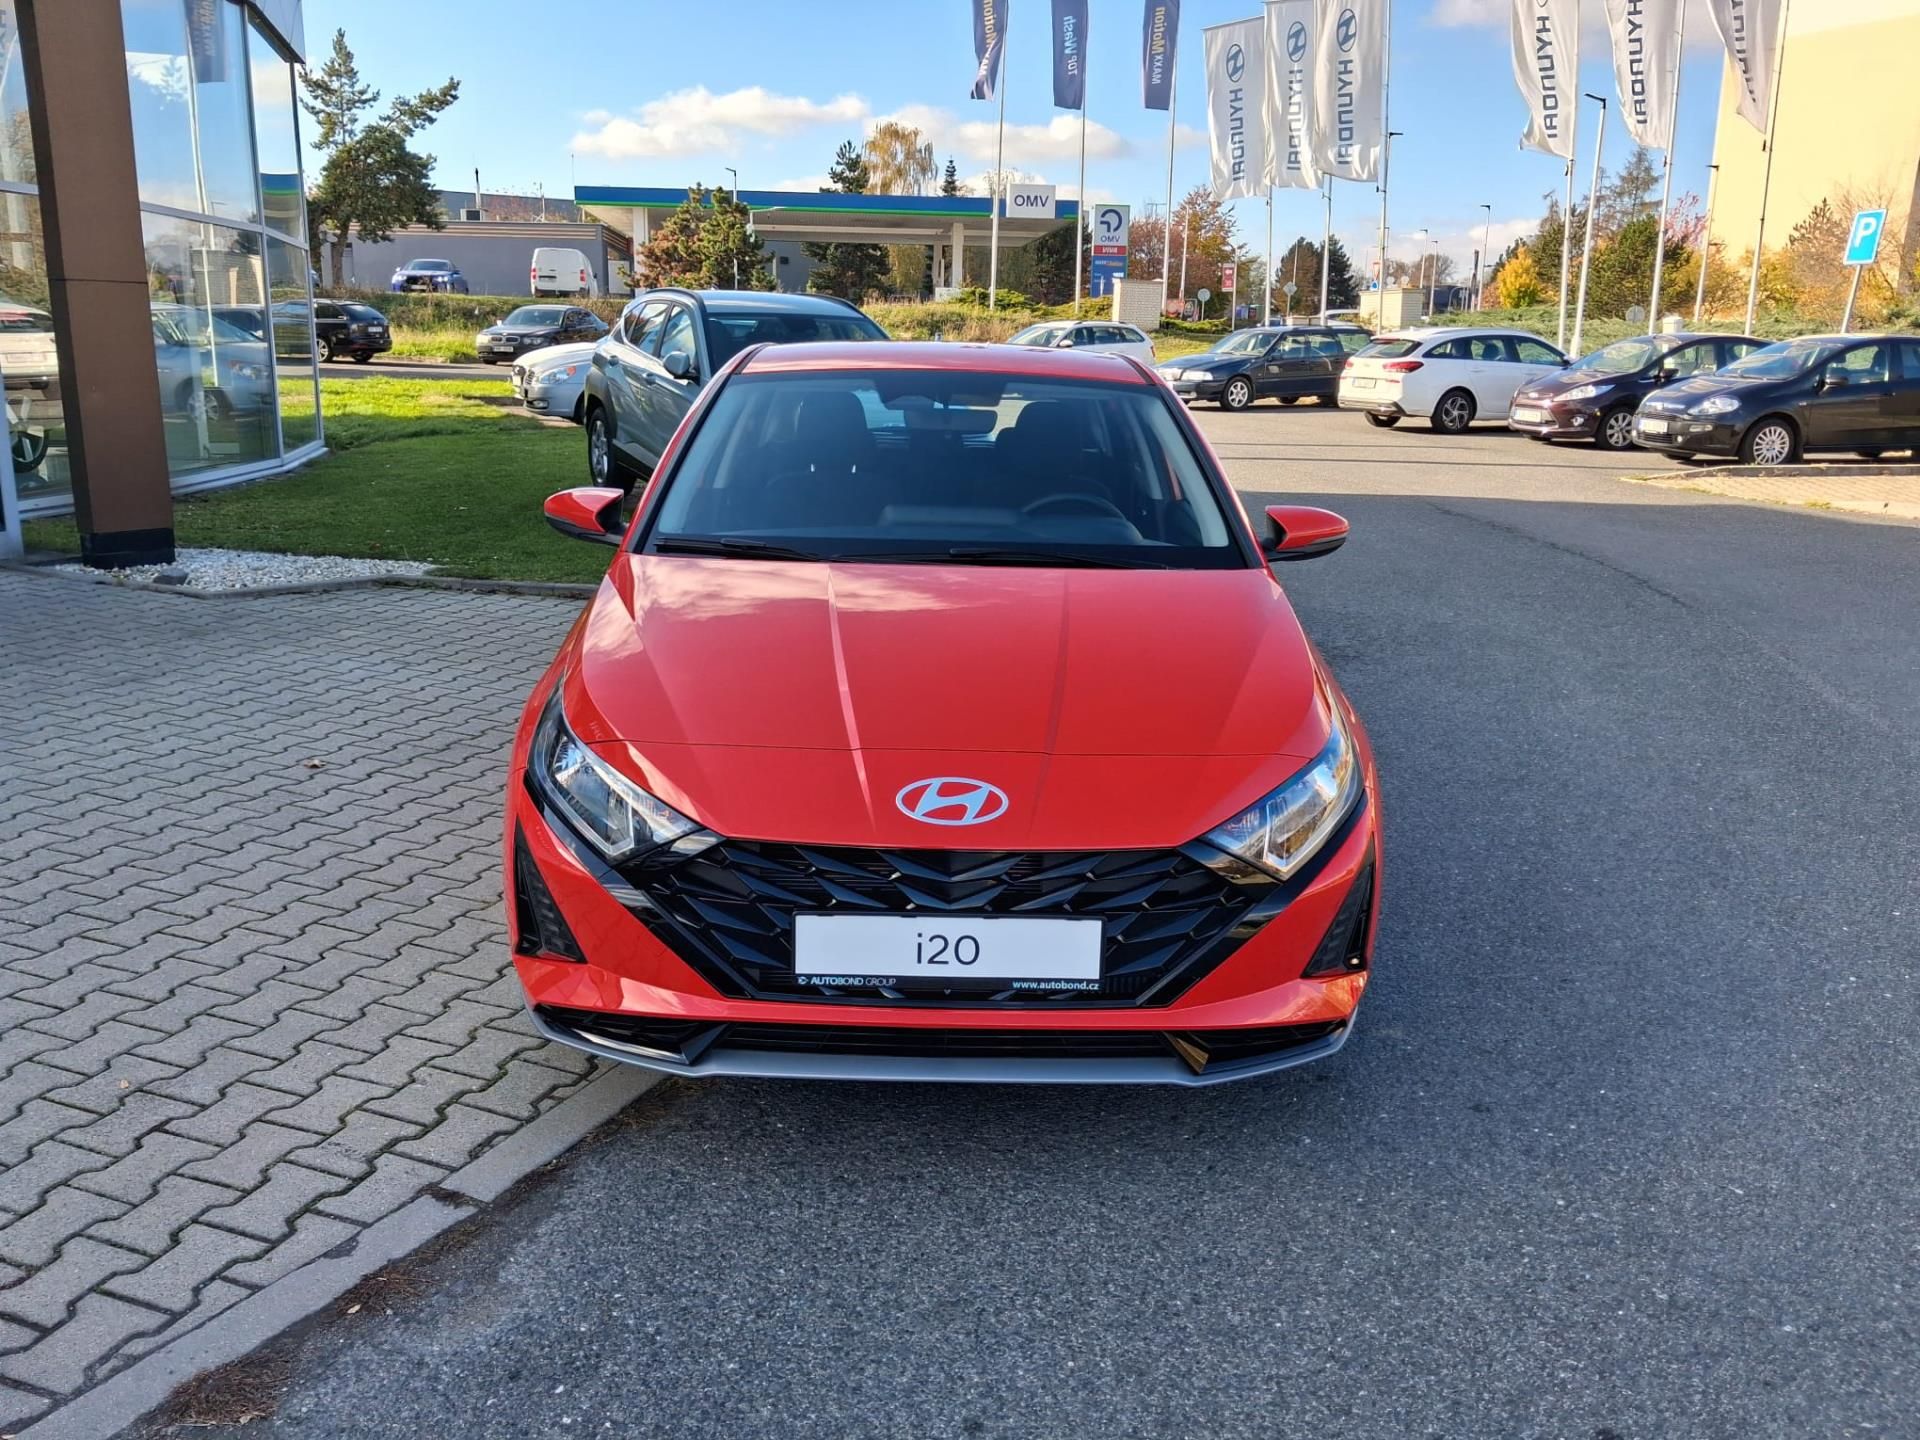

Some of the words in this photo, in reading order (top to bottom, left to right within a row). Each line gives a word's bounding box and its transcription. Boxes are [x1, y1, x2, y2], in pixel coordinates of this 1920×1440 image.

[1014, 194, 1049, 207] OMV
[1854, 217, 1877, 248] P
[1100, 235, 1121, 243] OMV
[916, 932, 981, 966] i20
[810, 976, 864, 986] AUTOBOND
[865, 977, 897, 987] GROUP
[1012, 980, 1100, 991] www.autobond.cz
